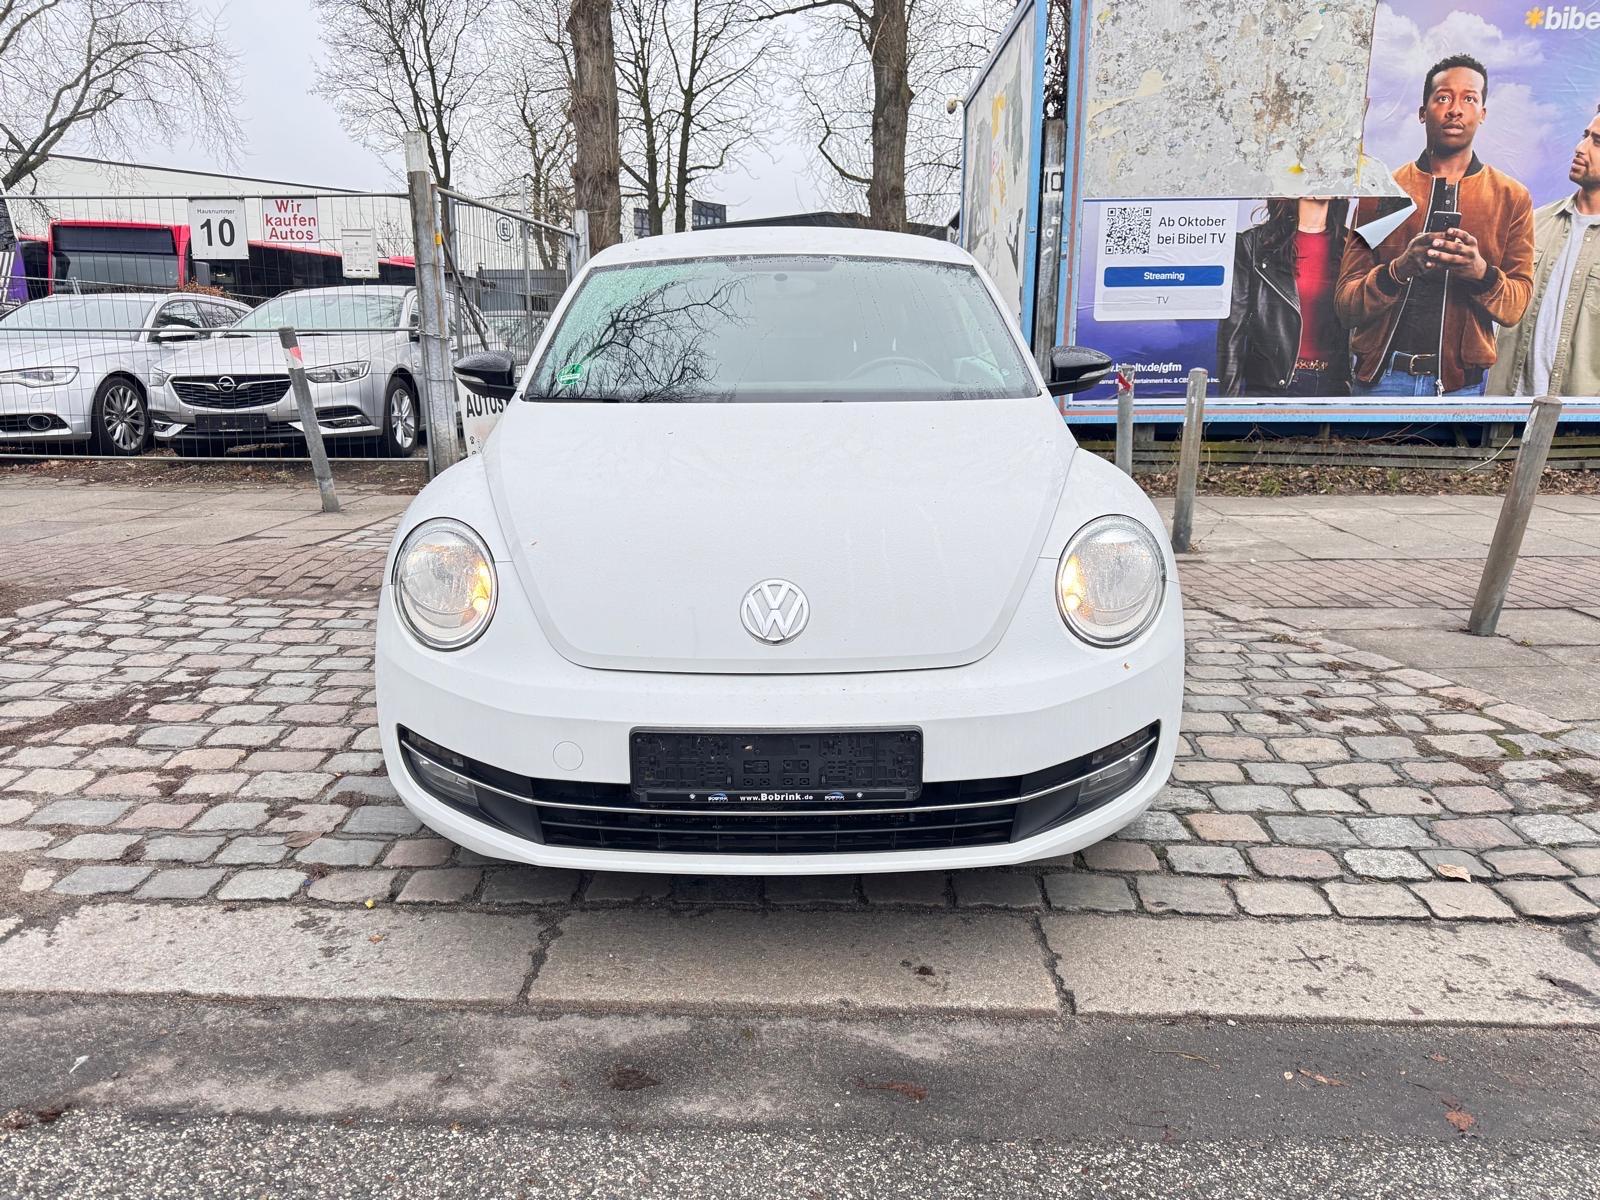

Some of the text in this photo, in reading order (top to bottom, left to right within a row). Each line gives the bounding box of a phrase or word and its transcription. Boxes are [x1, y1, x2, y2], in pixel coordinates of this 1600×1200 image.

[275, 200, 302, 213] Wir
[265, 214, 317, 227] kaufen
[1158, 216, 1226, 227] Ab Oktober
[200, 218, 235, 247] 10
[269, 228, 314, 241] Autos
[1157, 233, 1226, 244] bei Bibel TV
[1143, 272, 1185, 281] Streaming
[1156, 296, 1169, 304] TV
[740, 792, 814, 801] www.Bobrink.de
